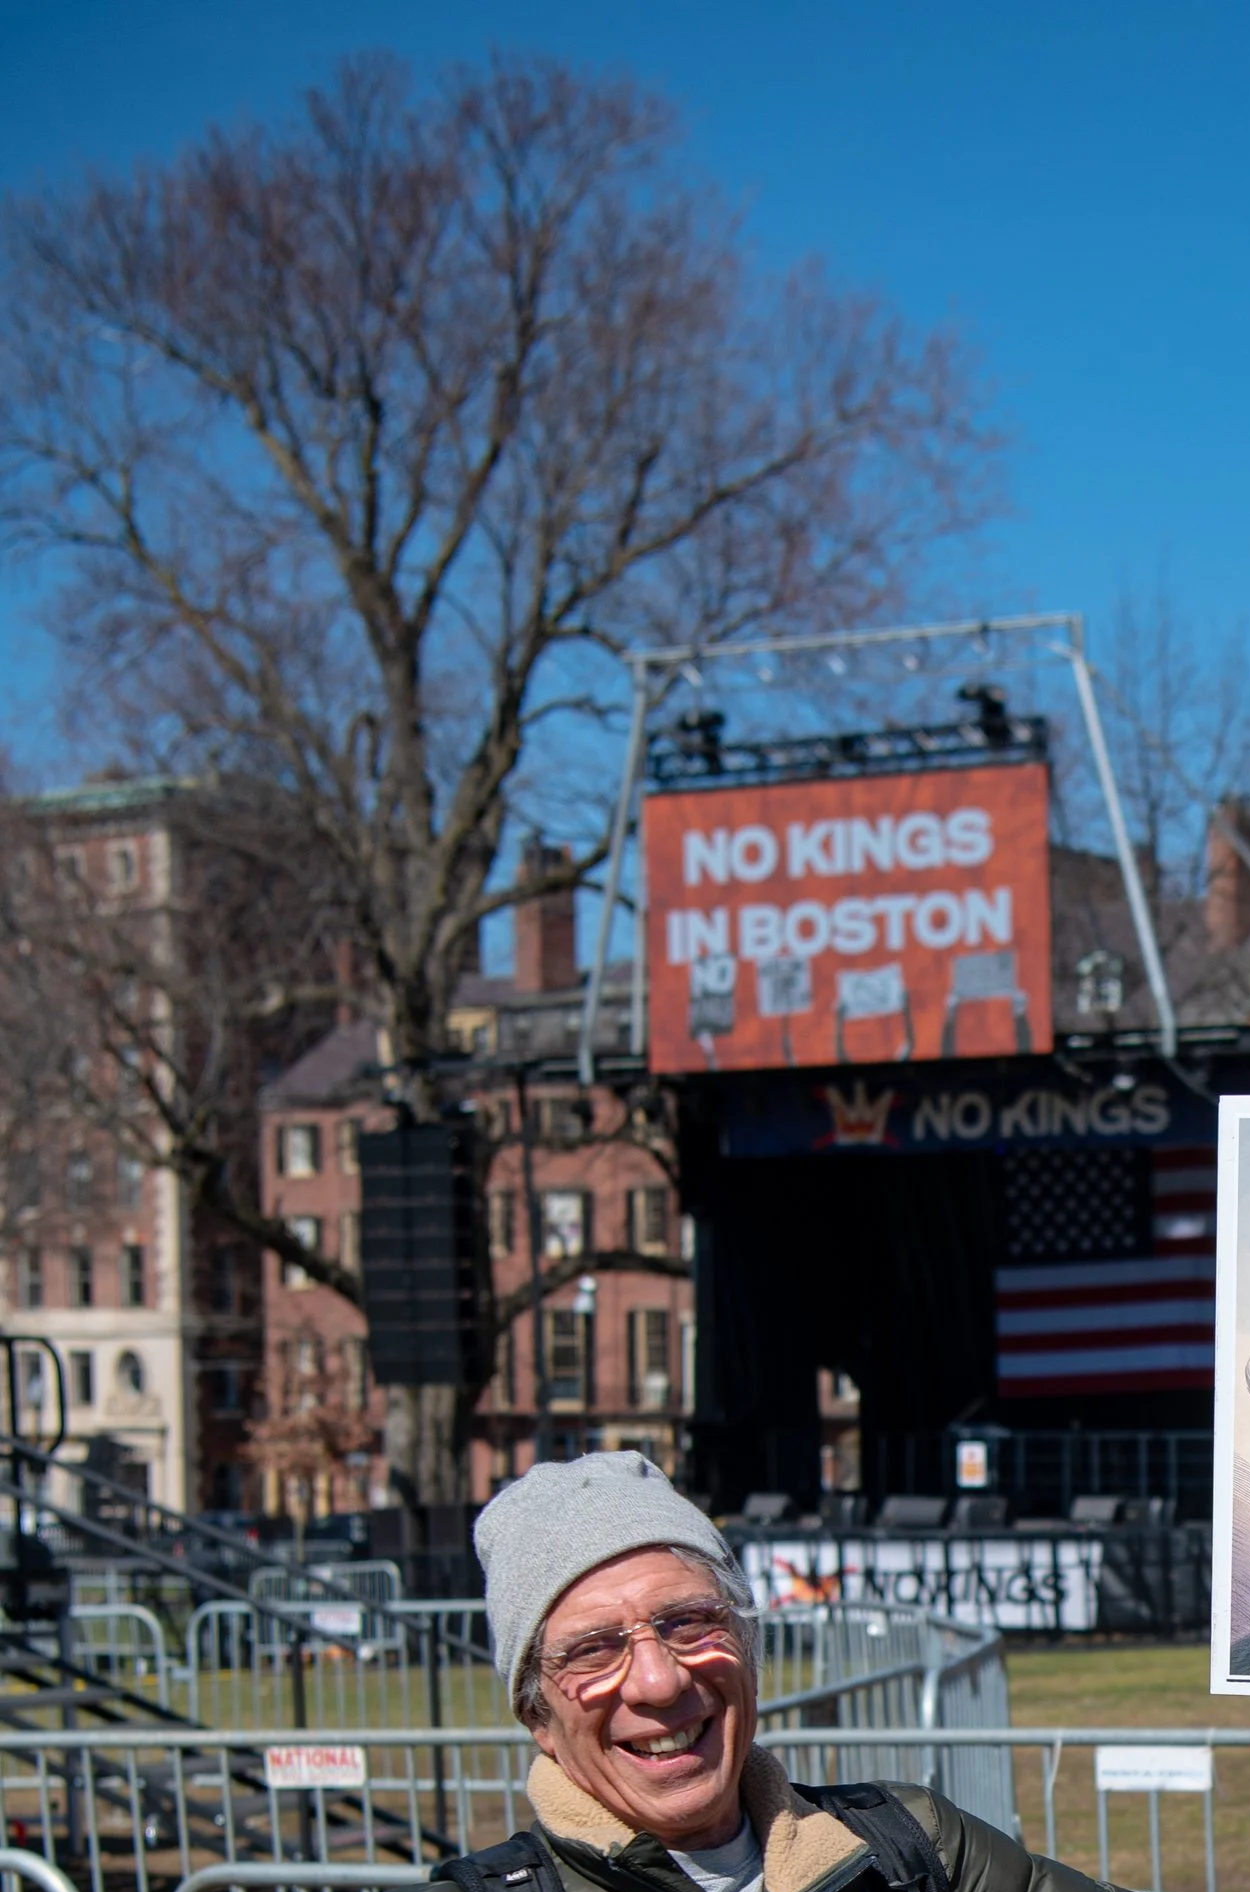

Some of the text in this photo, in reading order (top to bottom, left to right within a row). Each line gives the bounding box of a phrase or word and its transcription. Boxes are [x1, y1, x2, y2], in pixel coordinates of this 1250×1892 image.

[682, 807, 993, 887] NO KINGS
[666, 886, 1012, 966] IN BOSTON
[913, 1084, 1171, 1141] NO KINGS
[864, 1571, 923, 1605] NO
[268, 1746, 361, 1769] NATIONAL
